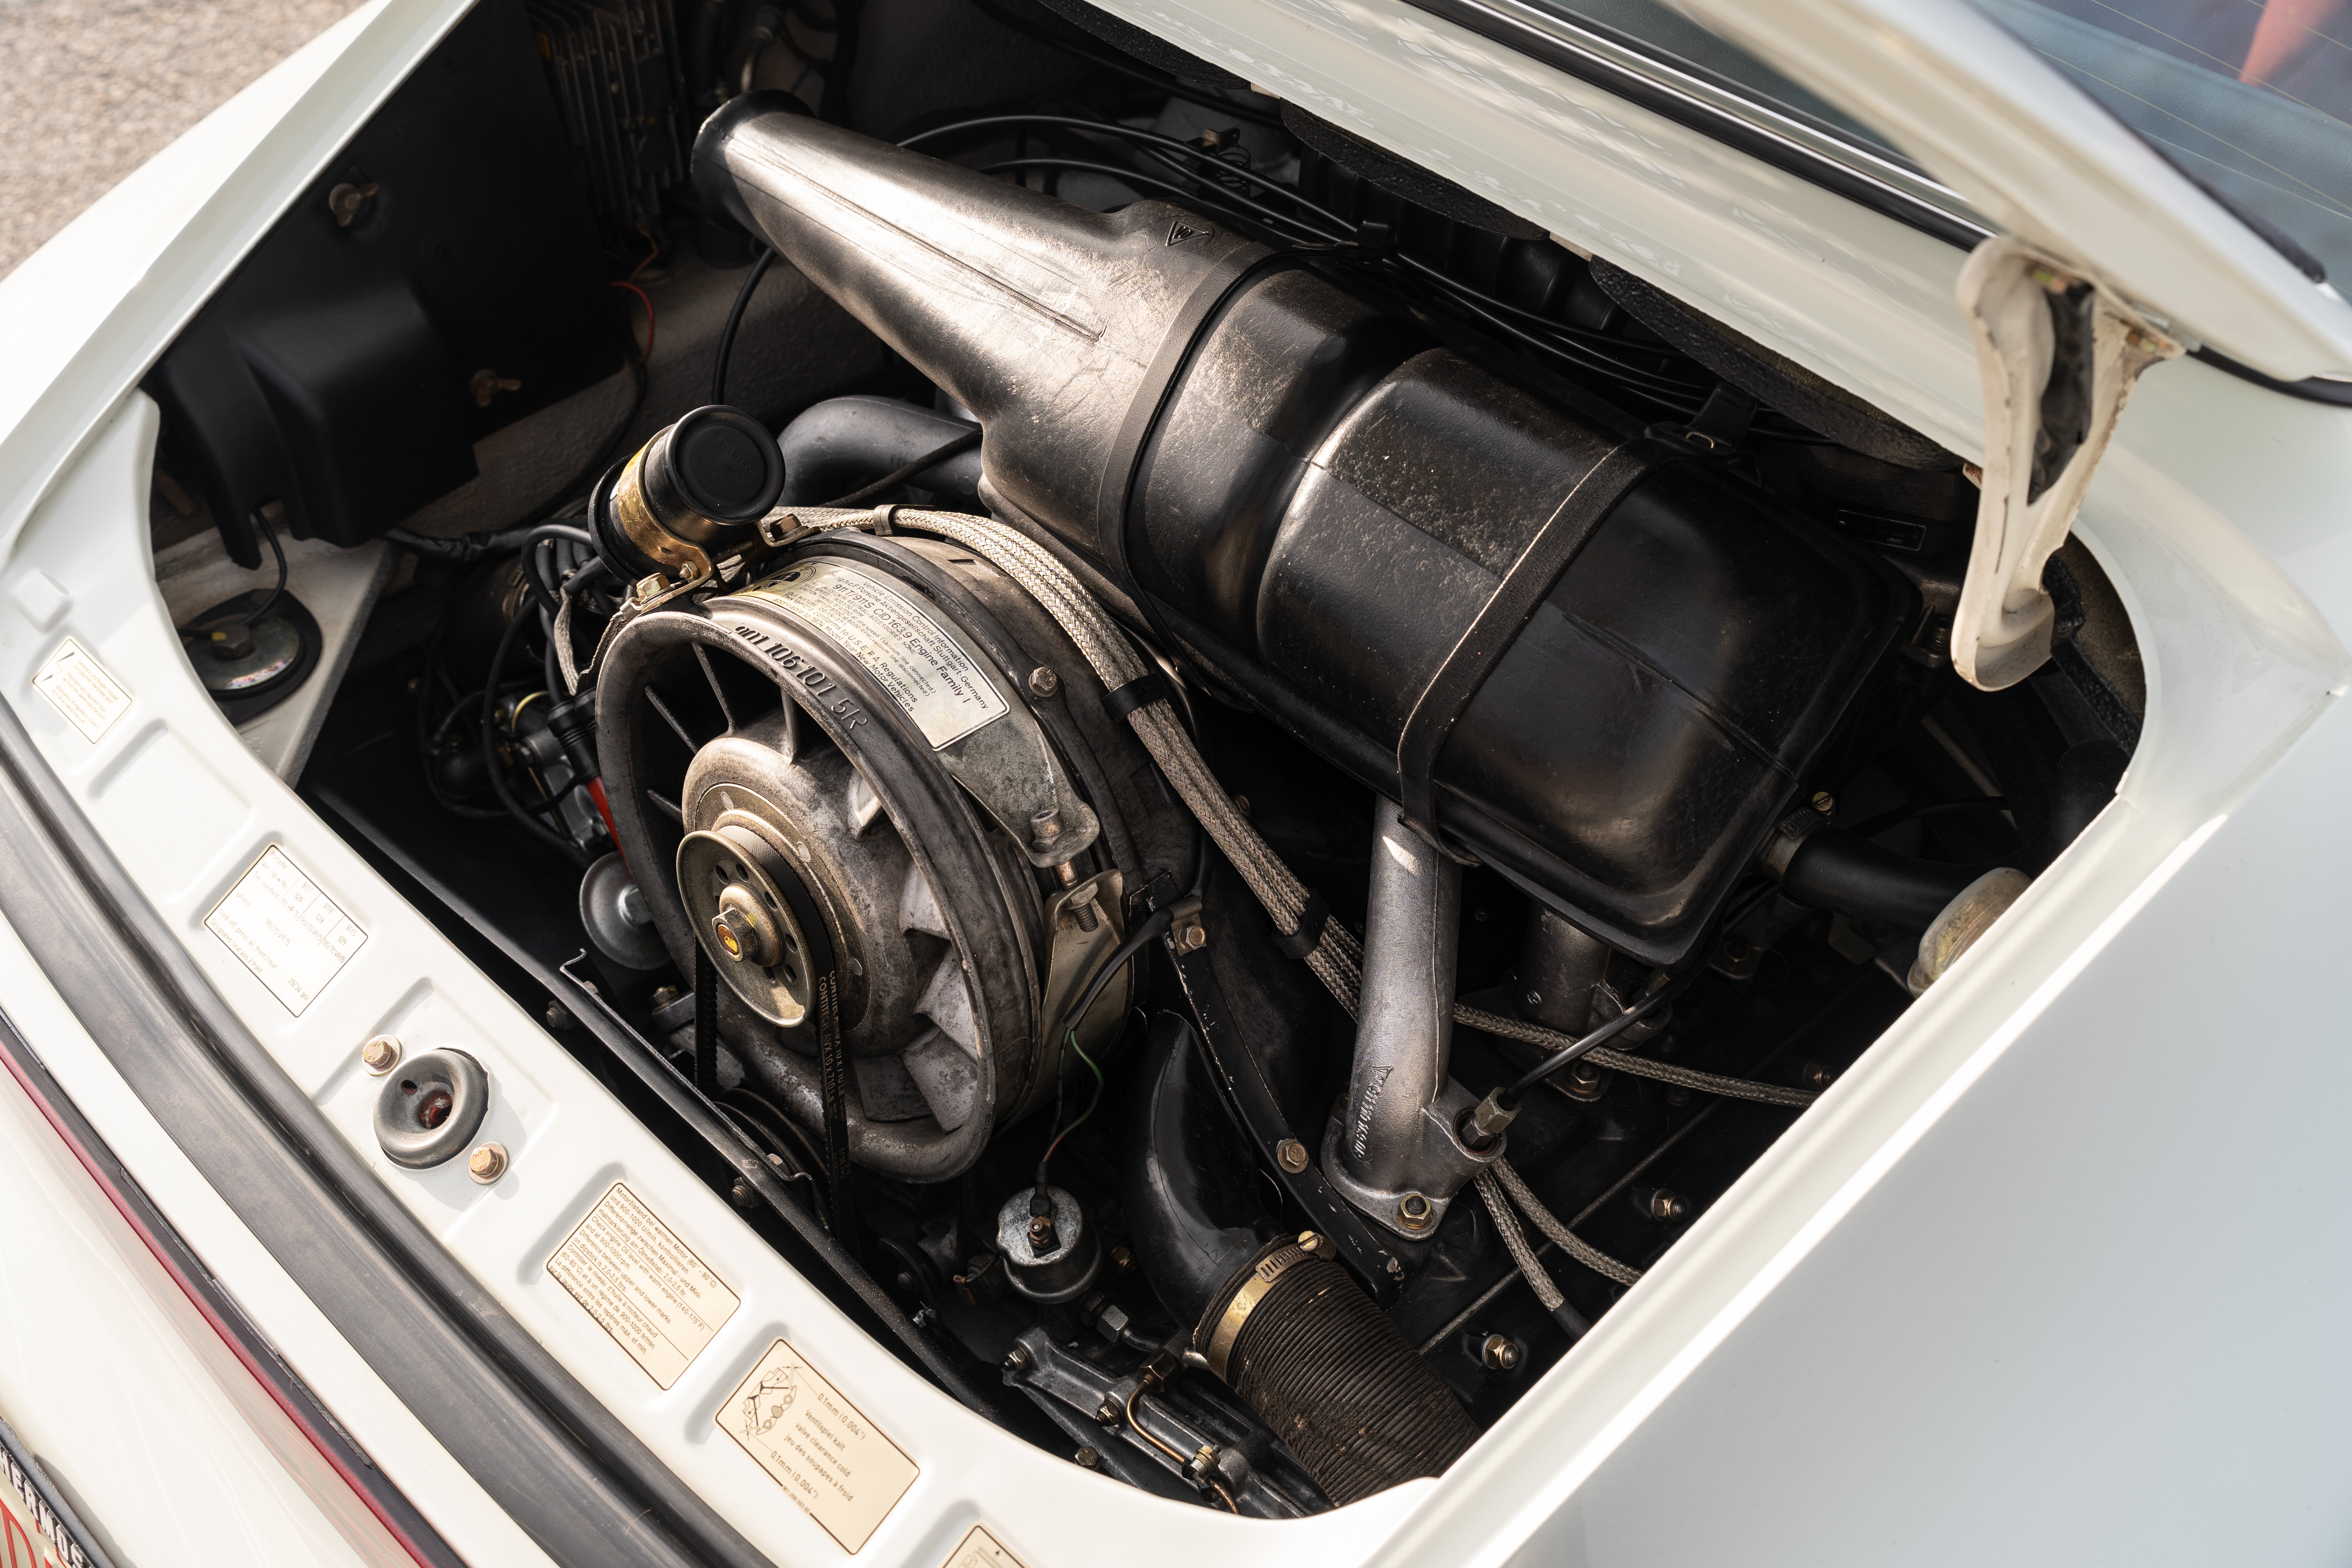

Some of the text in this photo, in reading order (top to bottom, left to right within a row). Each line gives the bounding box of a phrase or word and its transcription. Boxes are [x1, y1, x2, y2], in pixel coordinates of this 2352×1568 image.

[721, 439, 735, 452] 221
[798, 586, 818, 595] IGNITION
[865, 626, 880, 637] speed
[900, 656, 909, 665] line
[847, 619, 861, 629] 6000
[859, 628, 871, 637] RPM
[889, 654, 898, 663] line
[851, 609, 864, 617] RPM
[856, 586, 935, 646] Porsche Aktiengesellschaft
[863, 581, 968, 671] Vehicle Emission Control Information
[769, 598, 914, 711] applicable 1974 Model Year New Motor Vehicles
[793, 599, 813, 611] Vehicle
[813, 609, 844, 630] conforms
[879, 662, 917, 702] Regulations
[873, 608, 891, 620] CID
[909, 638, 938, 666] Engine
[936, 666, 964, 695] Family
[901, 641, 916, 654] NONE
[764, 643, 804, 668] 106
[796, 665, 837, 696] 101
[831, 698, 868, 731] 5R
[294, 893, 347, 945] 529 529 529
[288, 978, 302, 992] 29/34
[819, 976, 830, 1030] CONTITECH
[824, 1034, 832, 1054] AVX
[825, 1054, 833, 1065] 10
[580, 1243, 597, 1262] dipstick
[602, 1265, 619, 1283] 2,0-2,5
[585, 1223, 595, 1233] and
[599, 1237, 621, 1259] 900-1000
[619, 1258, 630, 1270] rpm.
[592, 1216, 677, 1303] Check engine level with warm engine
[598, 1209, 630, 1242] malmarkierung
[630, 1241, 638, 1249] am
[663, 1273, 681, 1290] 2,0-2,5
[604, 1201, 701, 1298] Differenzmenge zwischen Maximal und Mini-
[610, 1195, 688, 1274] und 900-1000 U/min. kontrollieren
[646, 1217, 655, 1227] bei
[654, 1226, 673, 1245] warmen
[673, 1243, 688, 1259] Motor
[548, 1264, 559, 1276] sur
[572, 1290, 583, 1302] est
[580, 1298, 590, 1309] de
[567, 1244, 658, 1338] Contrôler niveau d'huile moteur chaud
[579, 1229, 671, 1323] Difference between upper and lower marks
[561, 1265, 646, 1354] difference entre max. min.
[598, 1290, 654, 1350] régime 900-1000 tr/min.
[795, 1423, 851, 1477] valve clearance cold
[805, 1410, 845, 1450] Ventilspiel kalt
[783, 1434, 795, 1446] jeu
[795, 1445, 806, 1456] des
[806, 1455, 833, 1483] soupapes
[838, 1485, 853, 1501] froid
